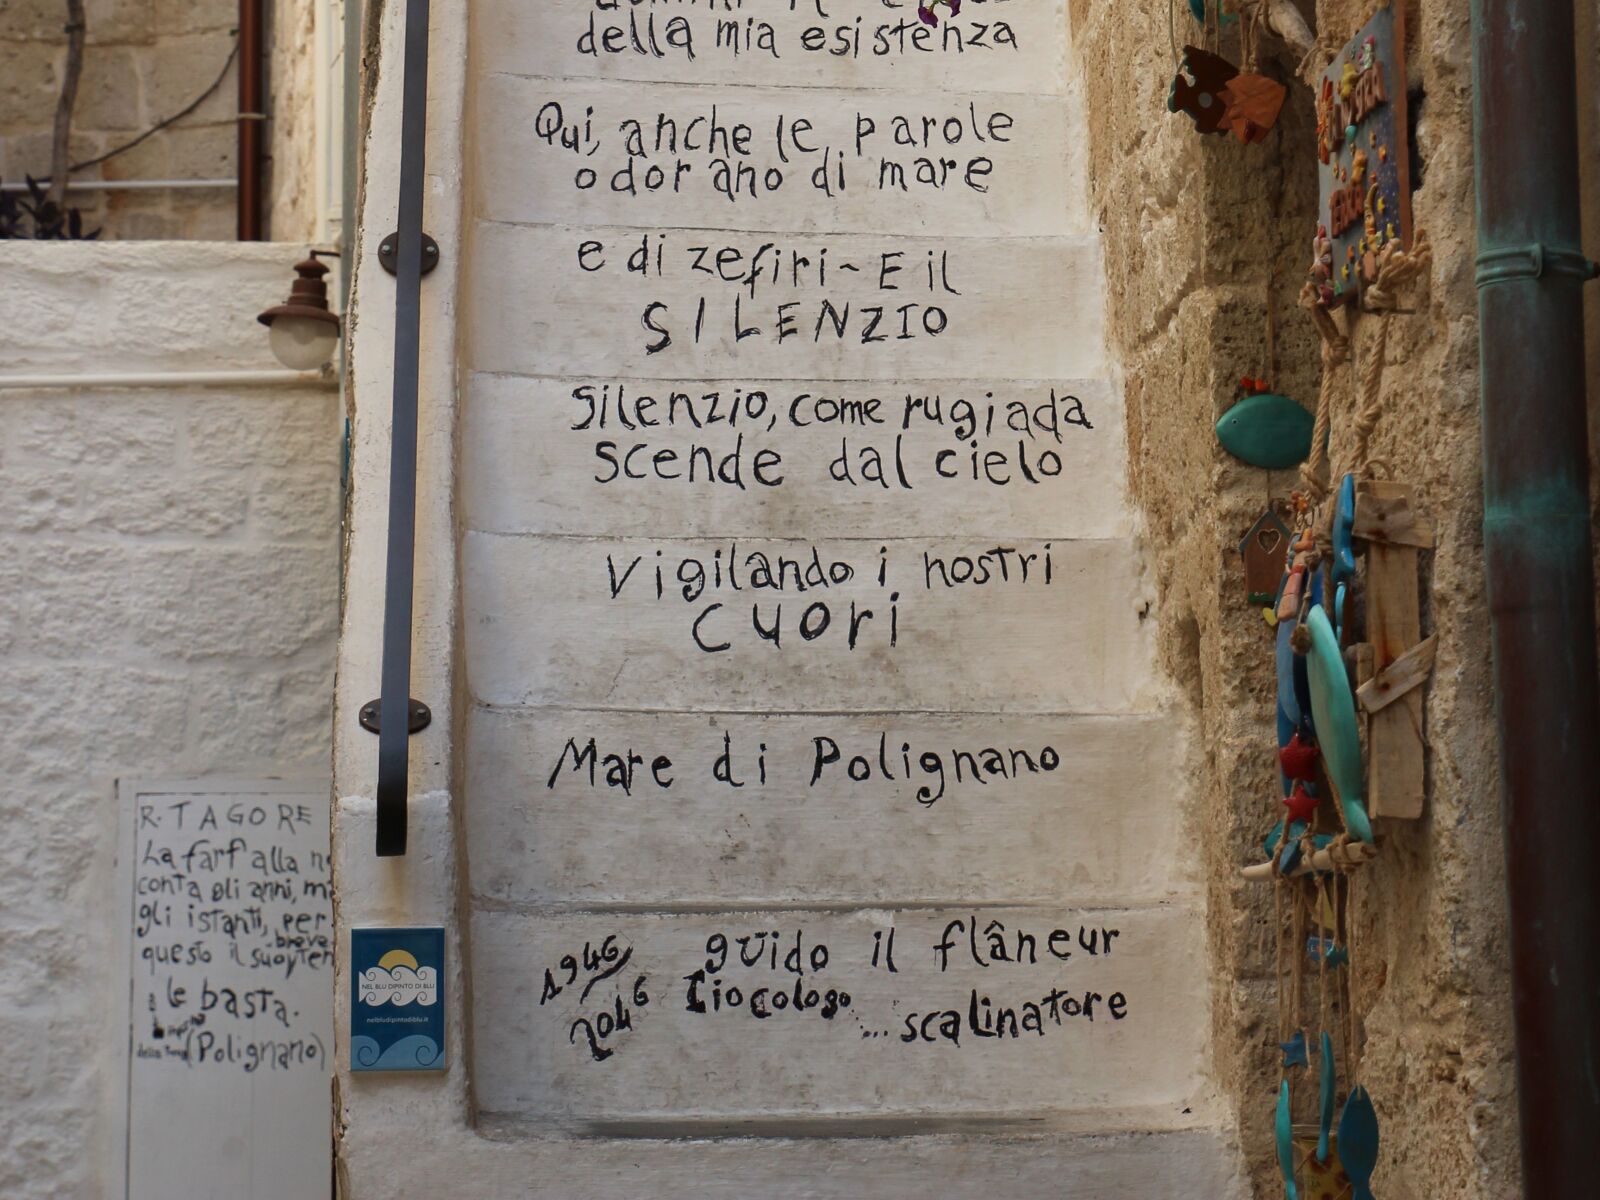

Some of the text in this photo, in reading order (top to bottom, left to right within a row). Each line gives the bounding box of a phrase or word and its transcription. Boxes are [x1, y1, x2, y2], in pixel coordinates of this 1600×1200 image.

[576, 7, 696, 63] della
[716, 16, 781, 59] mia
[618, 103, 752, 159] anche
[776, 114, 820, 164] le
[855, 101, 1014, 157] parole
[811, 145, 846, 198] di
[878, 156, 994, 194] mare
[577, 240, 606, 272] e
[626, 233, 664, 277] di
[879, 251, 905, 290] E
[927, 249, 962, 296] il
[640, 292, 948, 356] SILENZIO
[788, 393, 886, 427] come
[901, 387, 1095, 449] rugiada
[828, 433, 913, 490] dal
[934, 439, 1063, 486] cielo
[877, 545, 888, 588] i
[546, 729, 1060, 809] Mare di Polignano
[168, 801, 314, 837] TAGORE
[137, 899, 172, 939] gli
[871, 926, 899, 974] il
[932, 915, 1121, 973] flâneur
[167, 974, 187, 1009] le
